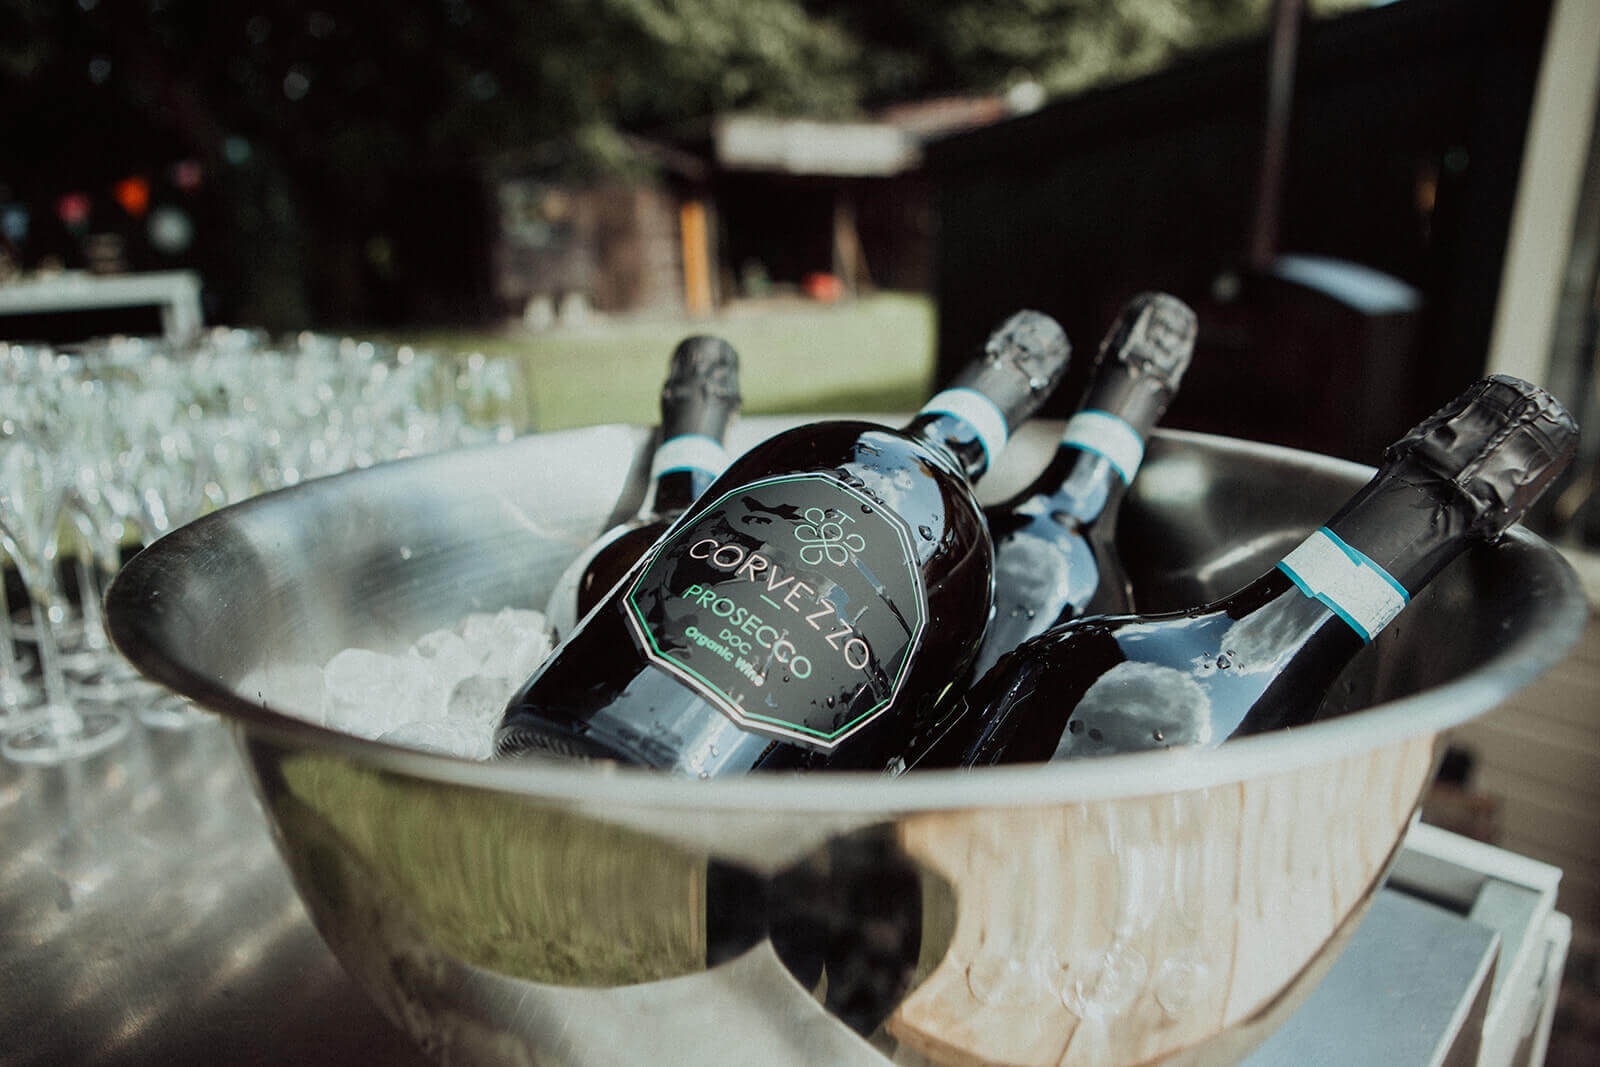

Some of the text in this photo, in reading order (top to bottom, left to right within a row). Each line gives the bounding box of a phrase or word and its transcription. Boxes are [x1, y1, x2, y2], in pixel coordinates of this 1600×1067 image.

[682, 584, 812, 679] PROSECCO
[689, 538, 870, 670] CORVEZZO
[718, 628, 752, 655] DOC
